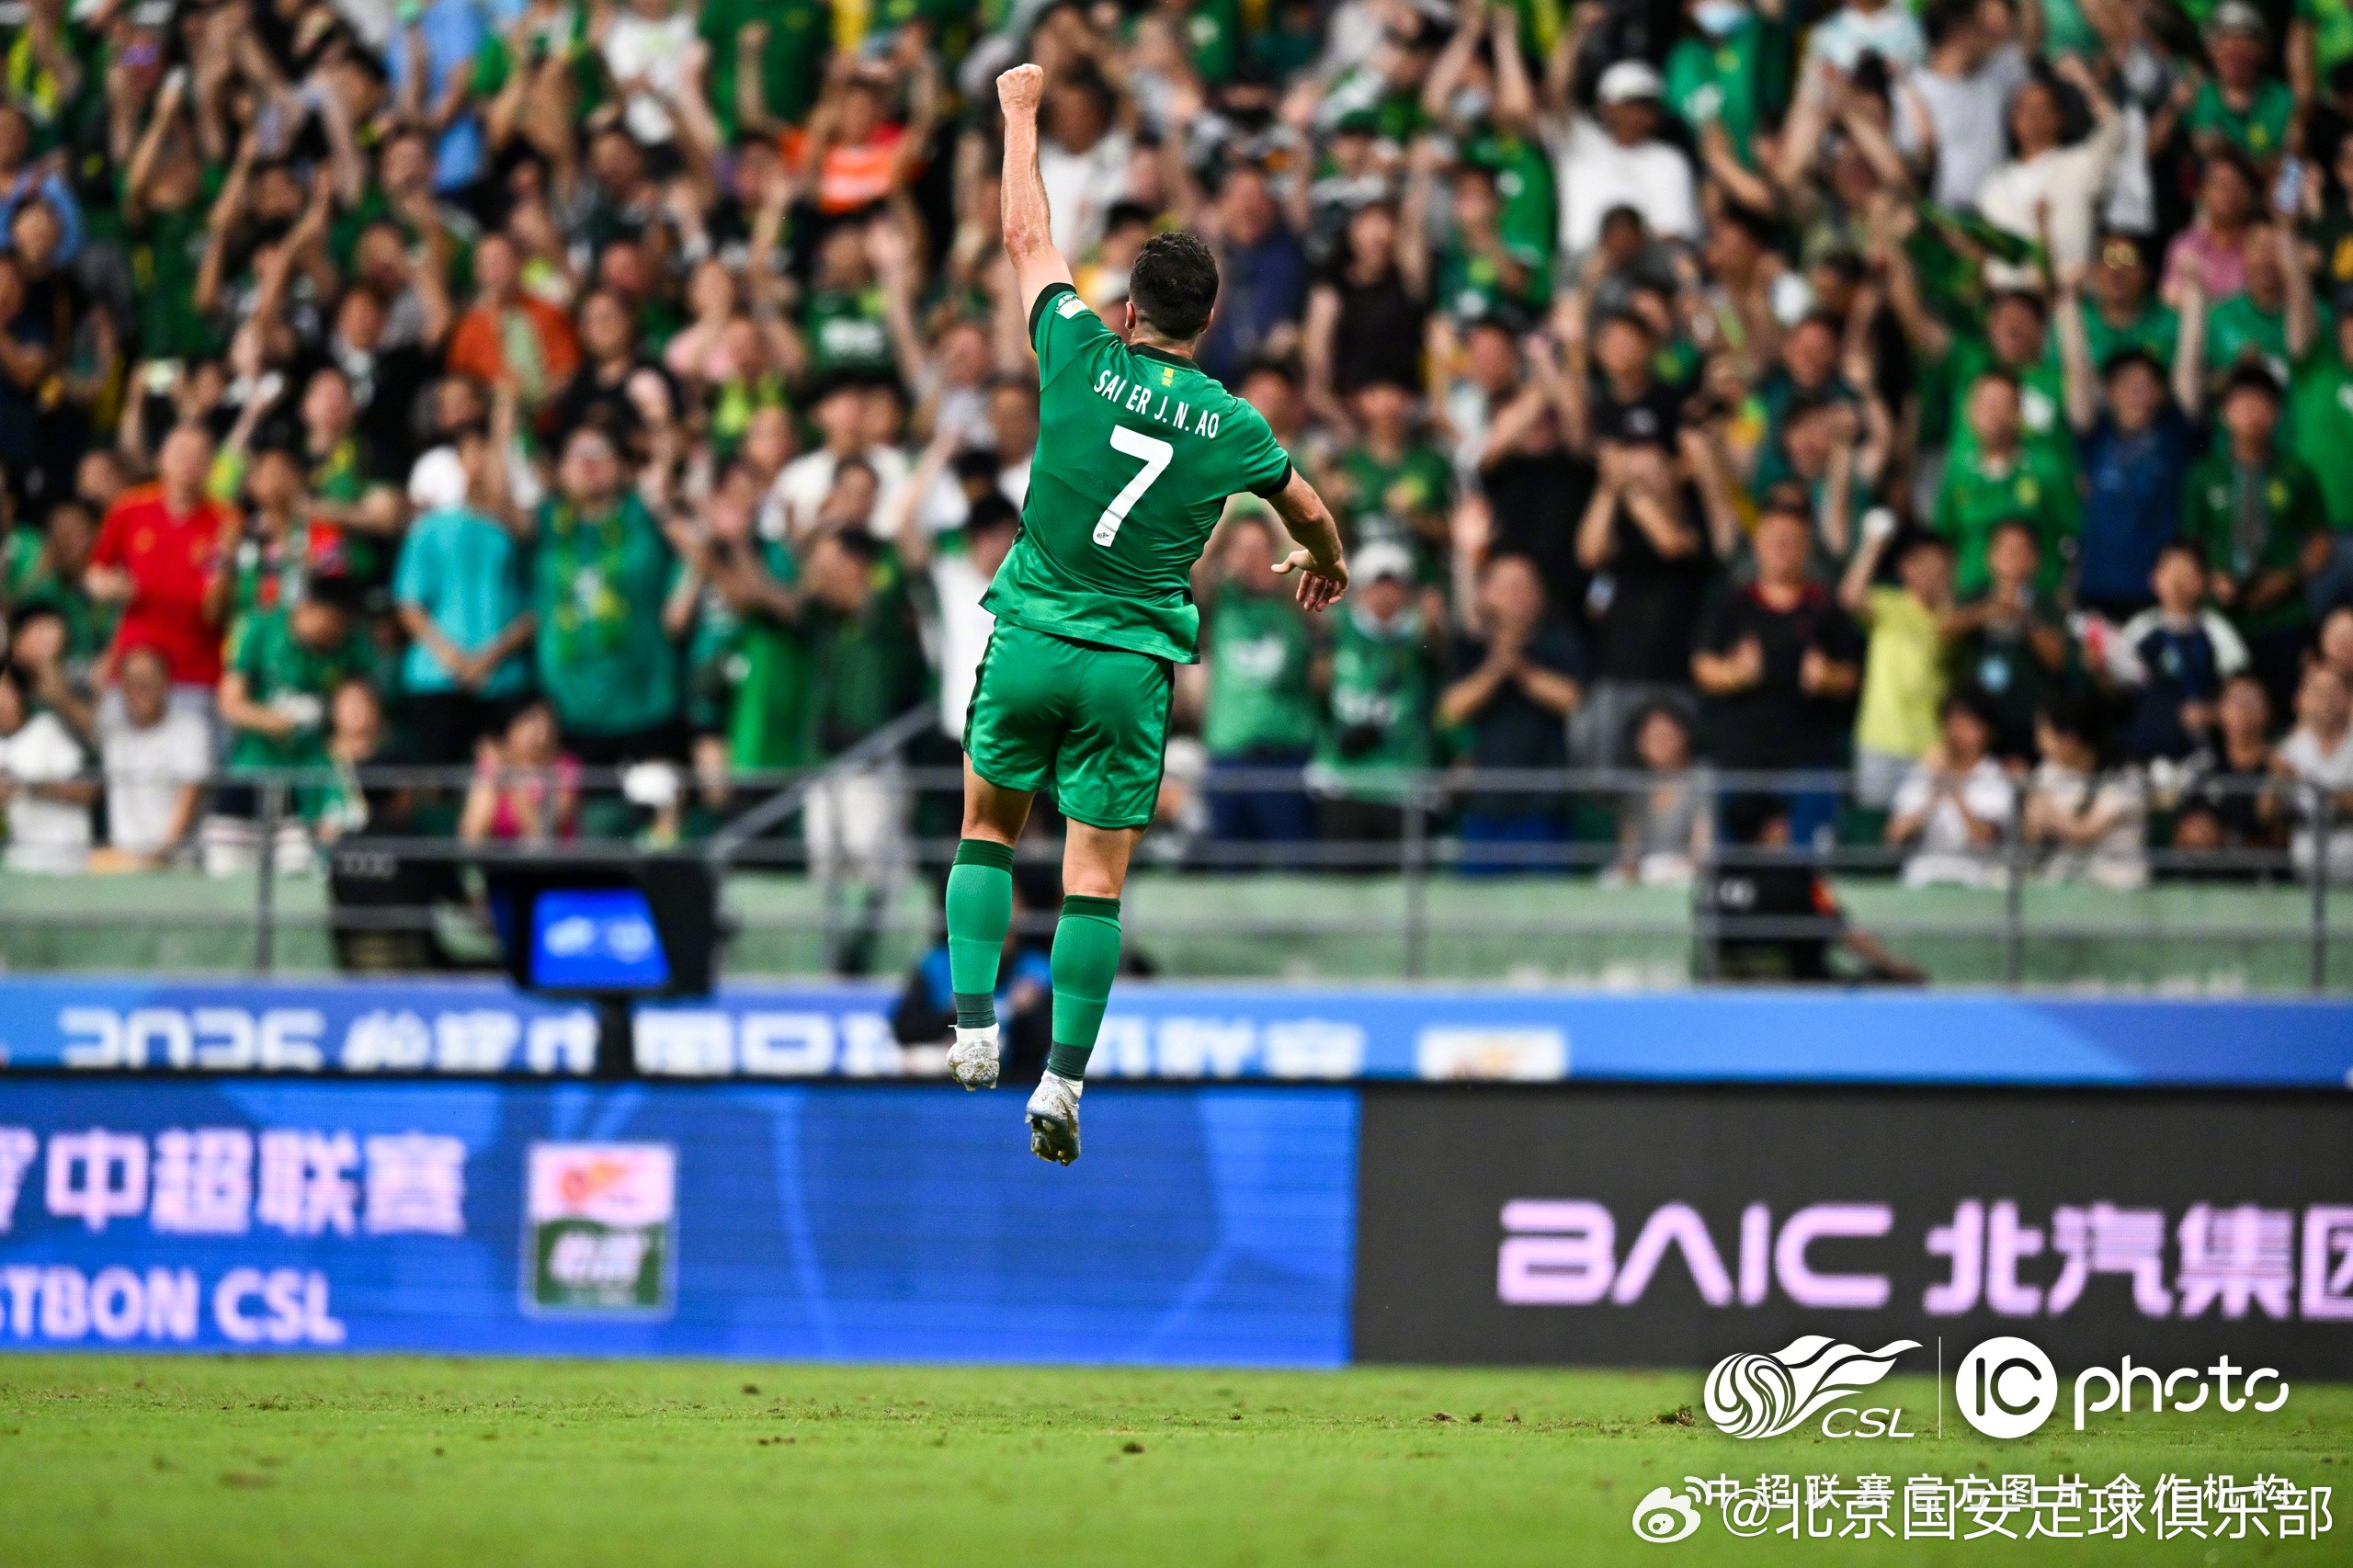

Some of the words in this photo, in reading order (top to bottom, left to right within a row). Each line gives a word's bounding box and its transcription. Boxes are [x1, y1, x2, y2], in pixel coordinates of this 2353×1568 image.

[1093, 369, 1127, 403] SAI
[1125, 384, 1152, 415] ER
[1194, 409, 1220, 438] AO
[1092, 424, 1174, 548] 7
[1497, 1200, 1893, 1307] BAIC
[0, 1267, 199, 1340] TBON
[215, 1268, 346, 1343] CSL
